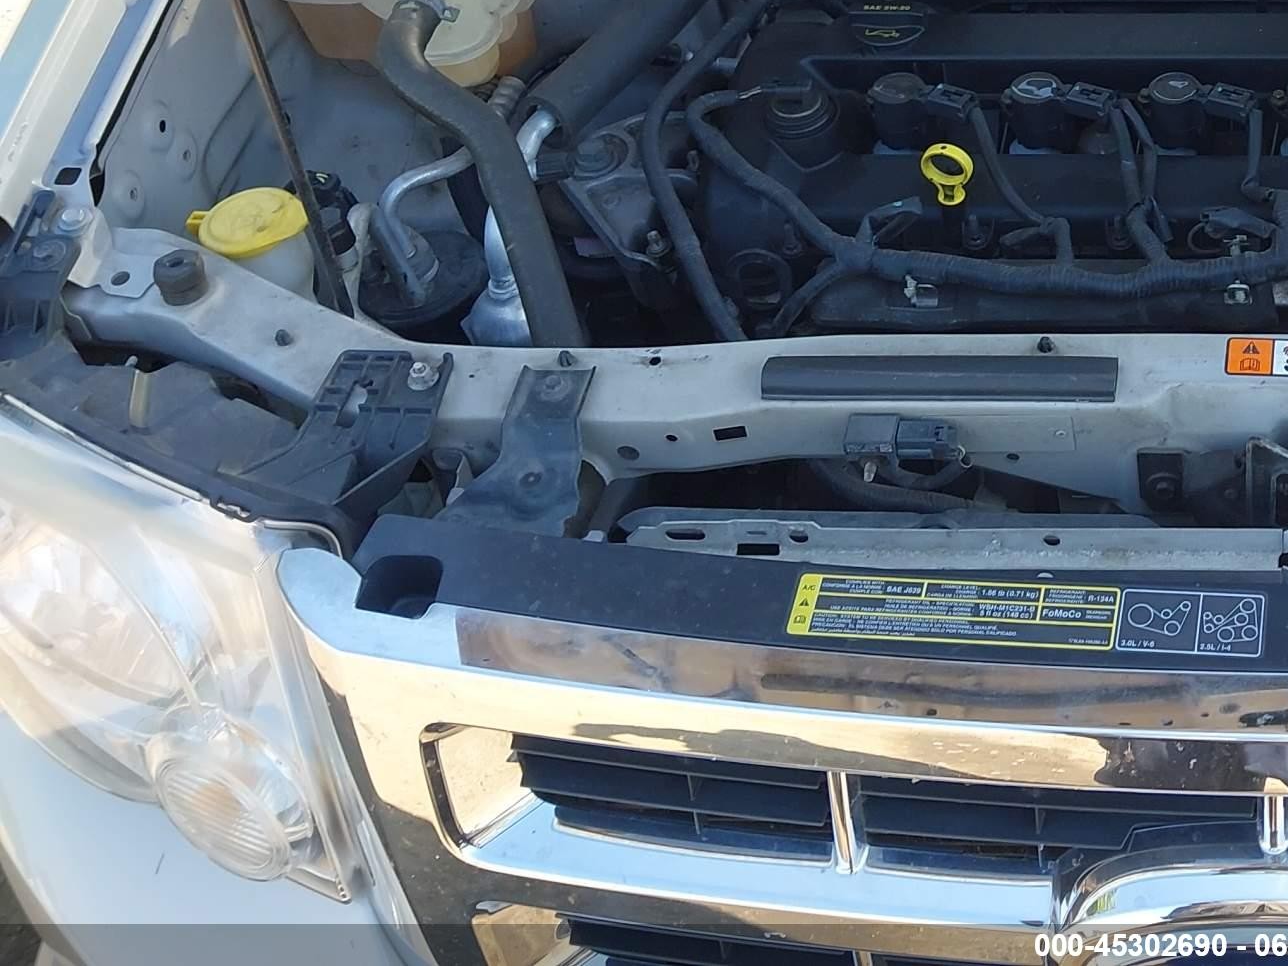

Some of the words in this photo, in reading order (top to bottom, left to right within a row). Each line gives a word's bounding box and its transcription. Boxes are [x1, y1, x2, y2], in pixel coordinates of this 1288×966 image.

[802, 584, 816, 592] A/C
[1088, 594, 1114, 603] R-134A
[1042, 608, 1082, 619] FoMoCo
